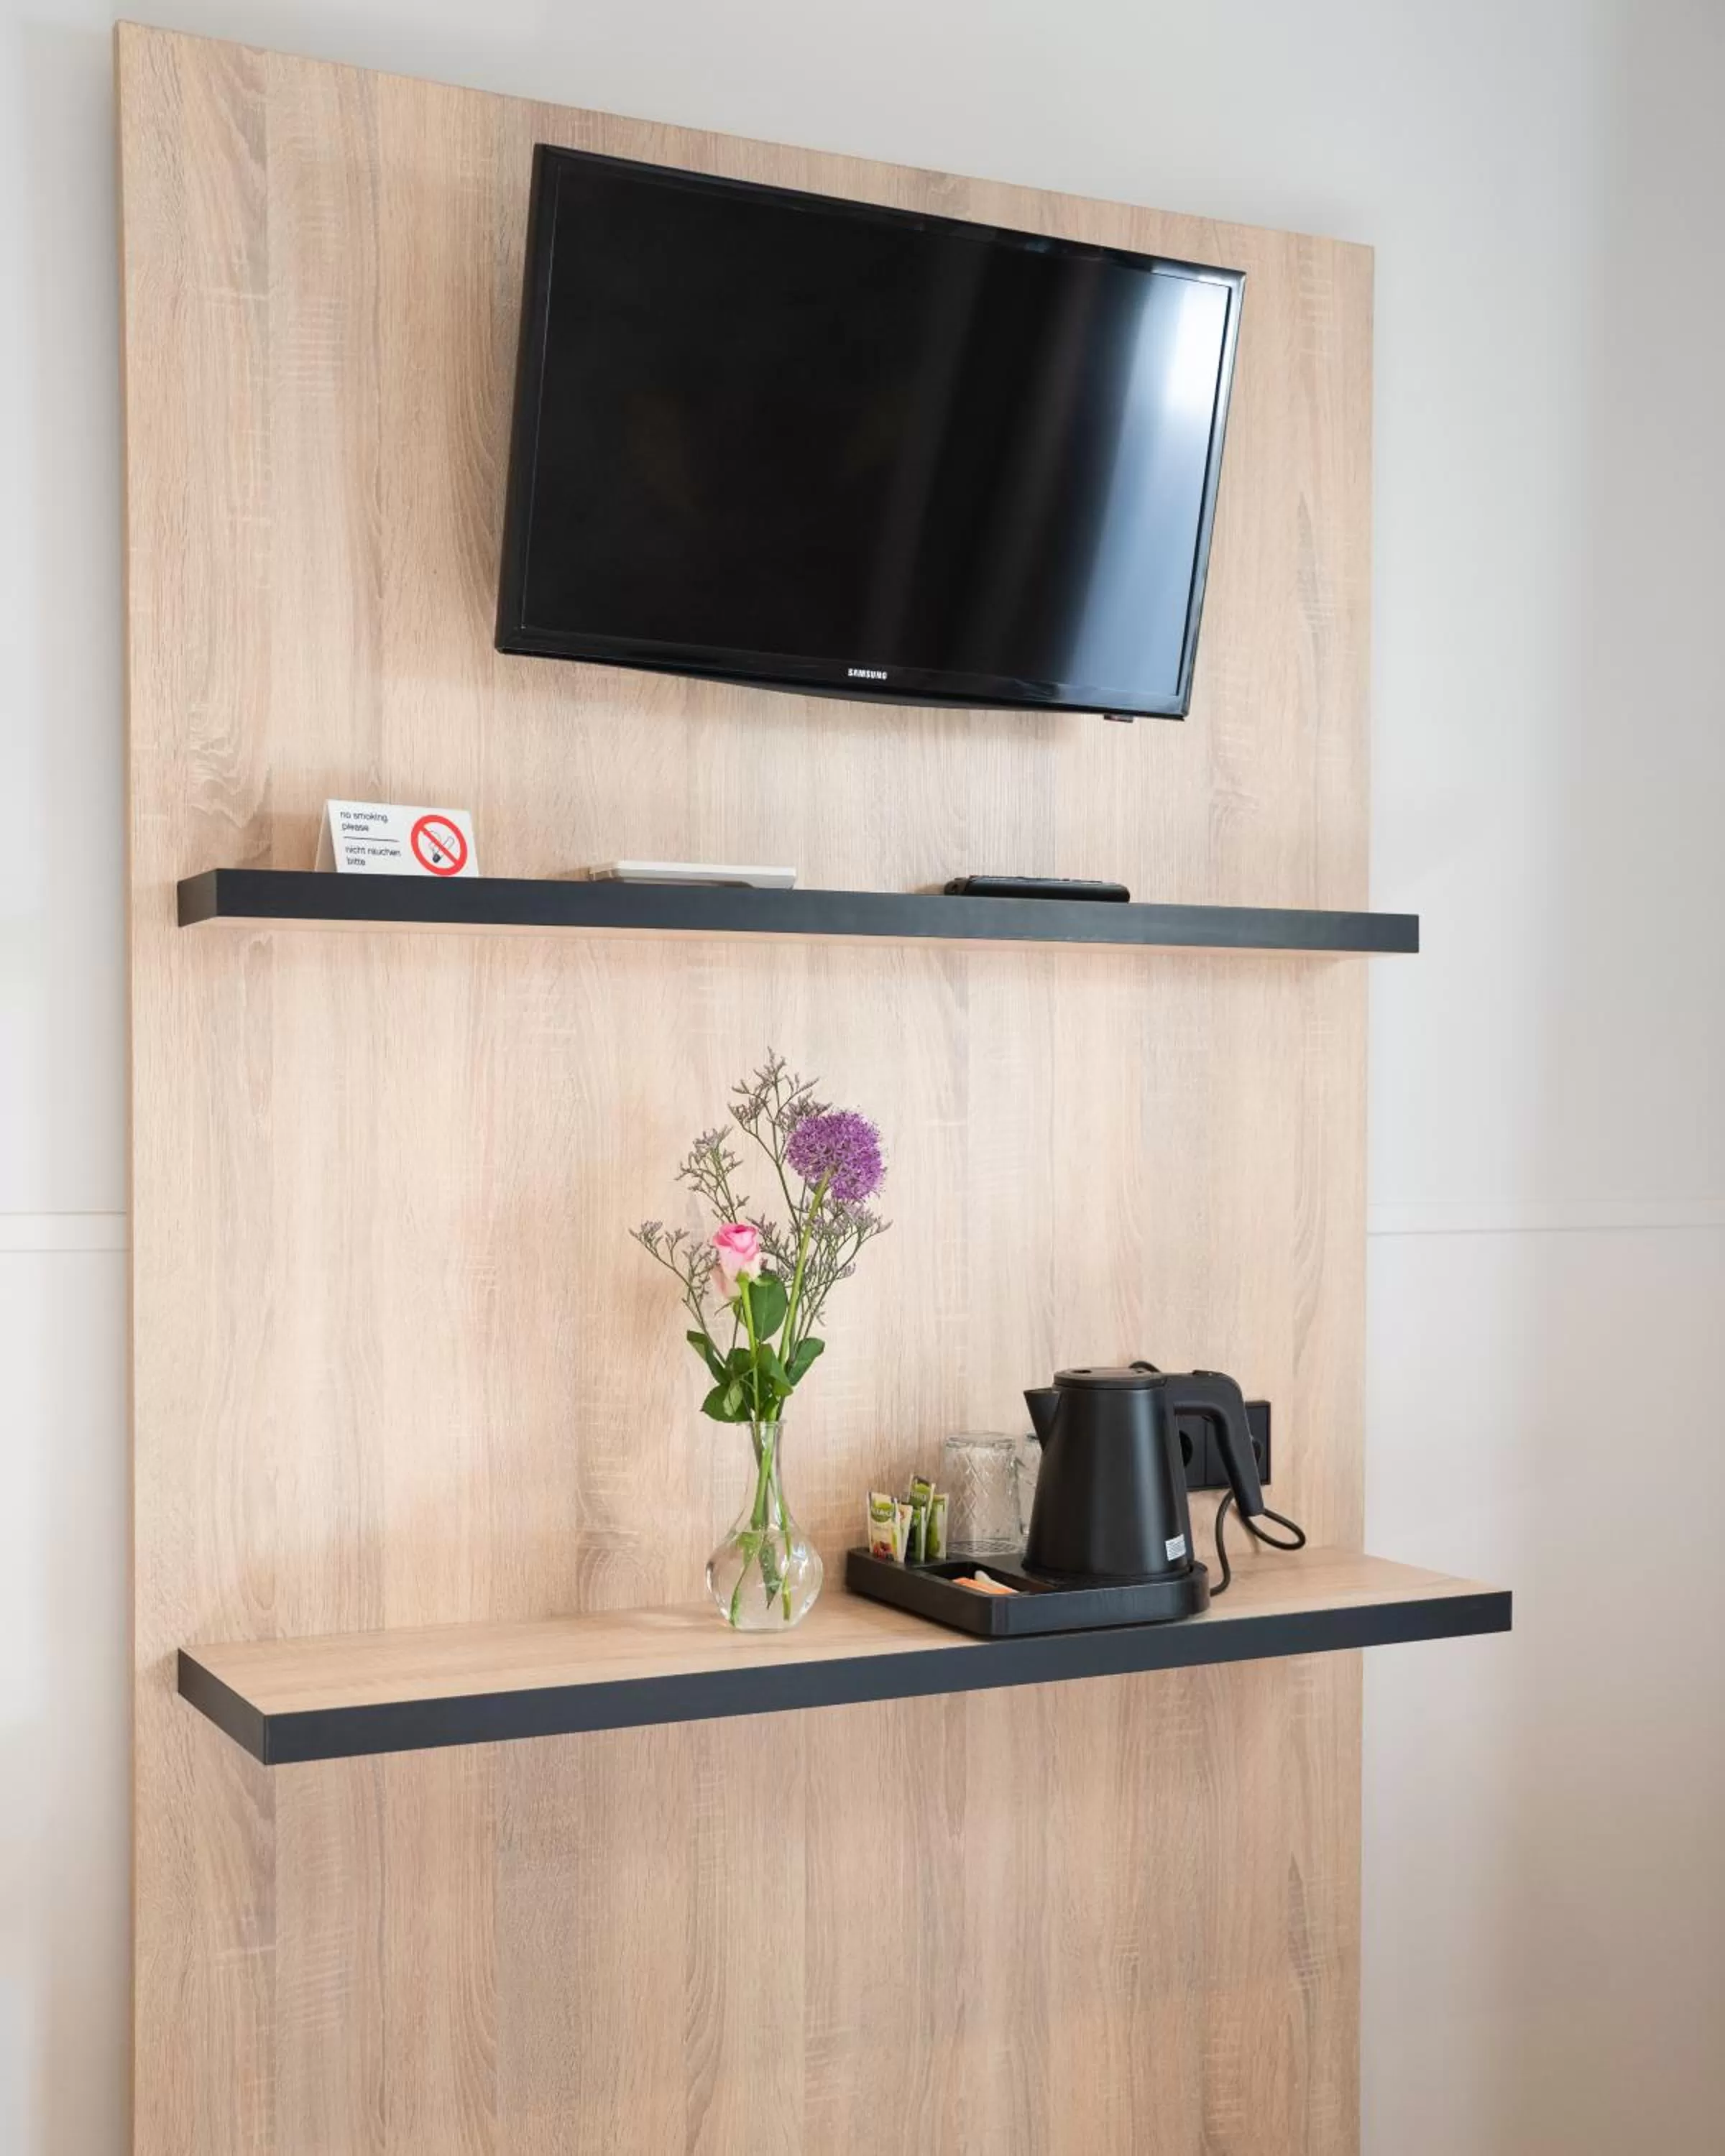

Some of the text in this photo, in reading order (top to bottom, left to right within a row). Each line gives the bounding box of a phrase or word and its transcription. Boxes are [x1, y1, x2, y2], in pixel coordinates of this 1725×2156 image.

[848, 668, 887, 680] SAMSUNG
[353, 811, 388, 823] smoking
[342, 823, 369, 832] please
[345, 845, 401, 857] nicht rauchen
[347, 856, 366, 865] bitte
